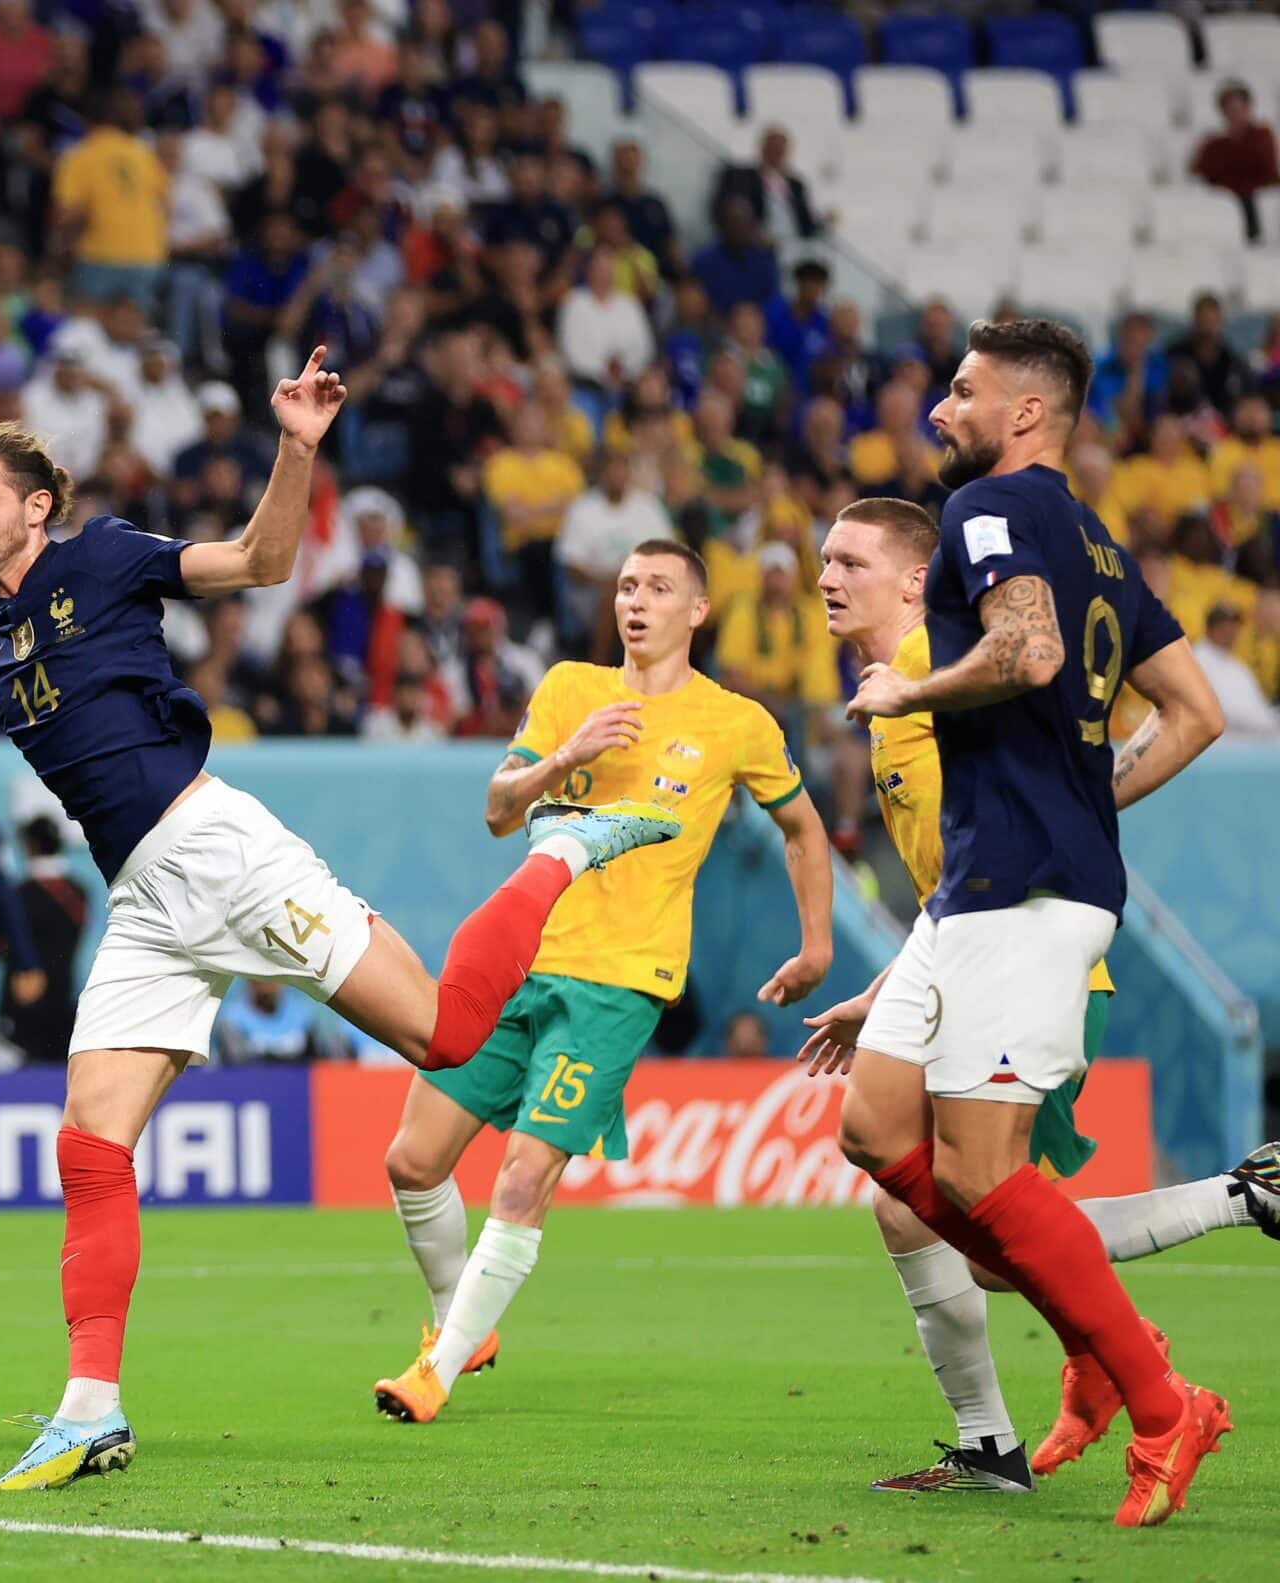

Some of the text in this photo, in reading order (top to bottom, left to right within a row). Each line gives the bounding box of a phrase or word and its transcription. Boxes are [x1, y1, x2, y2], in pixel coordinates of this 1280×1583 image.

[11, 661, 61, 726] 14
[1078, 595, 1123, 747] 9
[262, 898, 331, 966] 14
[540, 1054, 594, 1110] 15
